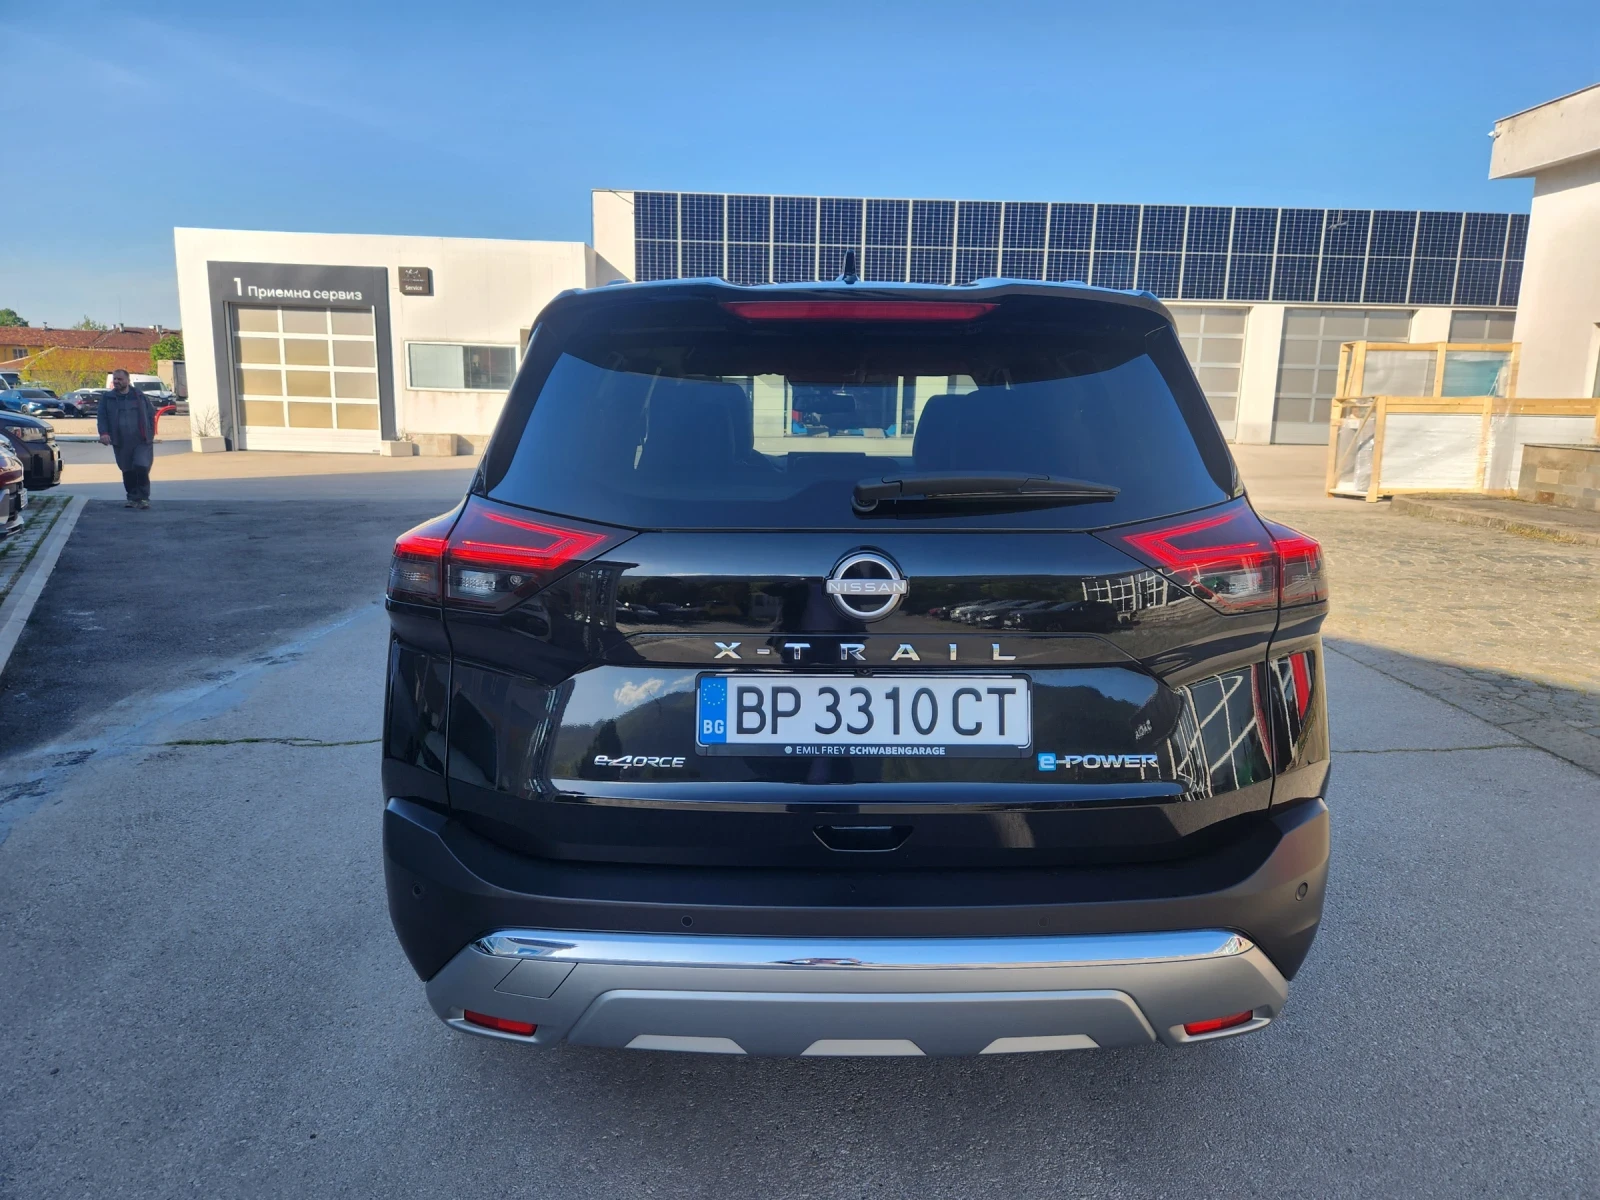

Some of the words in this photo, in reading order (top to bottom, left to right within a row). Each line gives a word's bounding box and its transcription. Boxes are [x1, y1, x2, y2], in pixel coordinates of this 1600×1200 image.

[233, 277, 243, 296] 1
[247, 285, 311, 299] Приемна
[312, 289, 363, 302] сервиз
[828, 582, 905, 592] NISSAN
[814, 686, 939, 735] 3310
[703, 719, 725, 735] BG
[796, 746, 820, 755] EMIL
[822, 746, 847, 755] FREY
[849, 746, 946, 755] SCHWABENGARAGE
